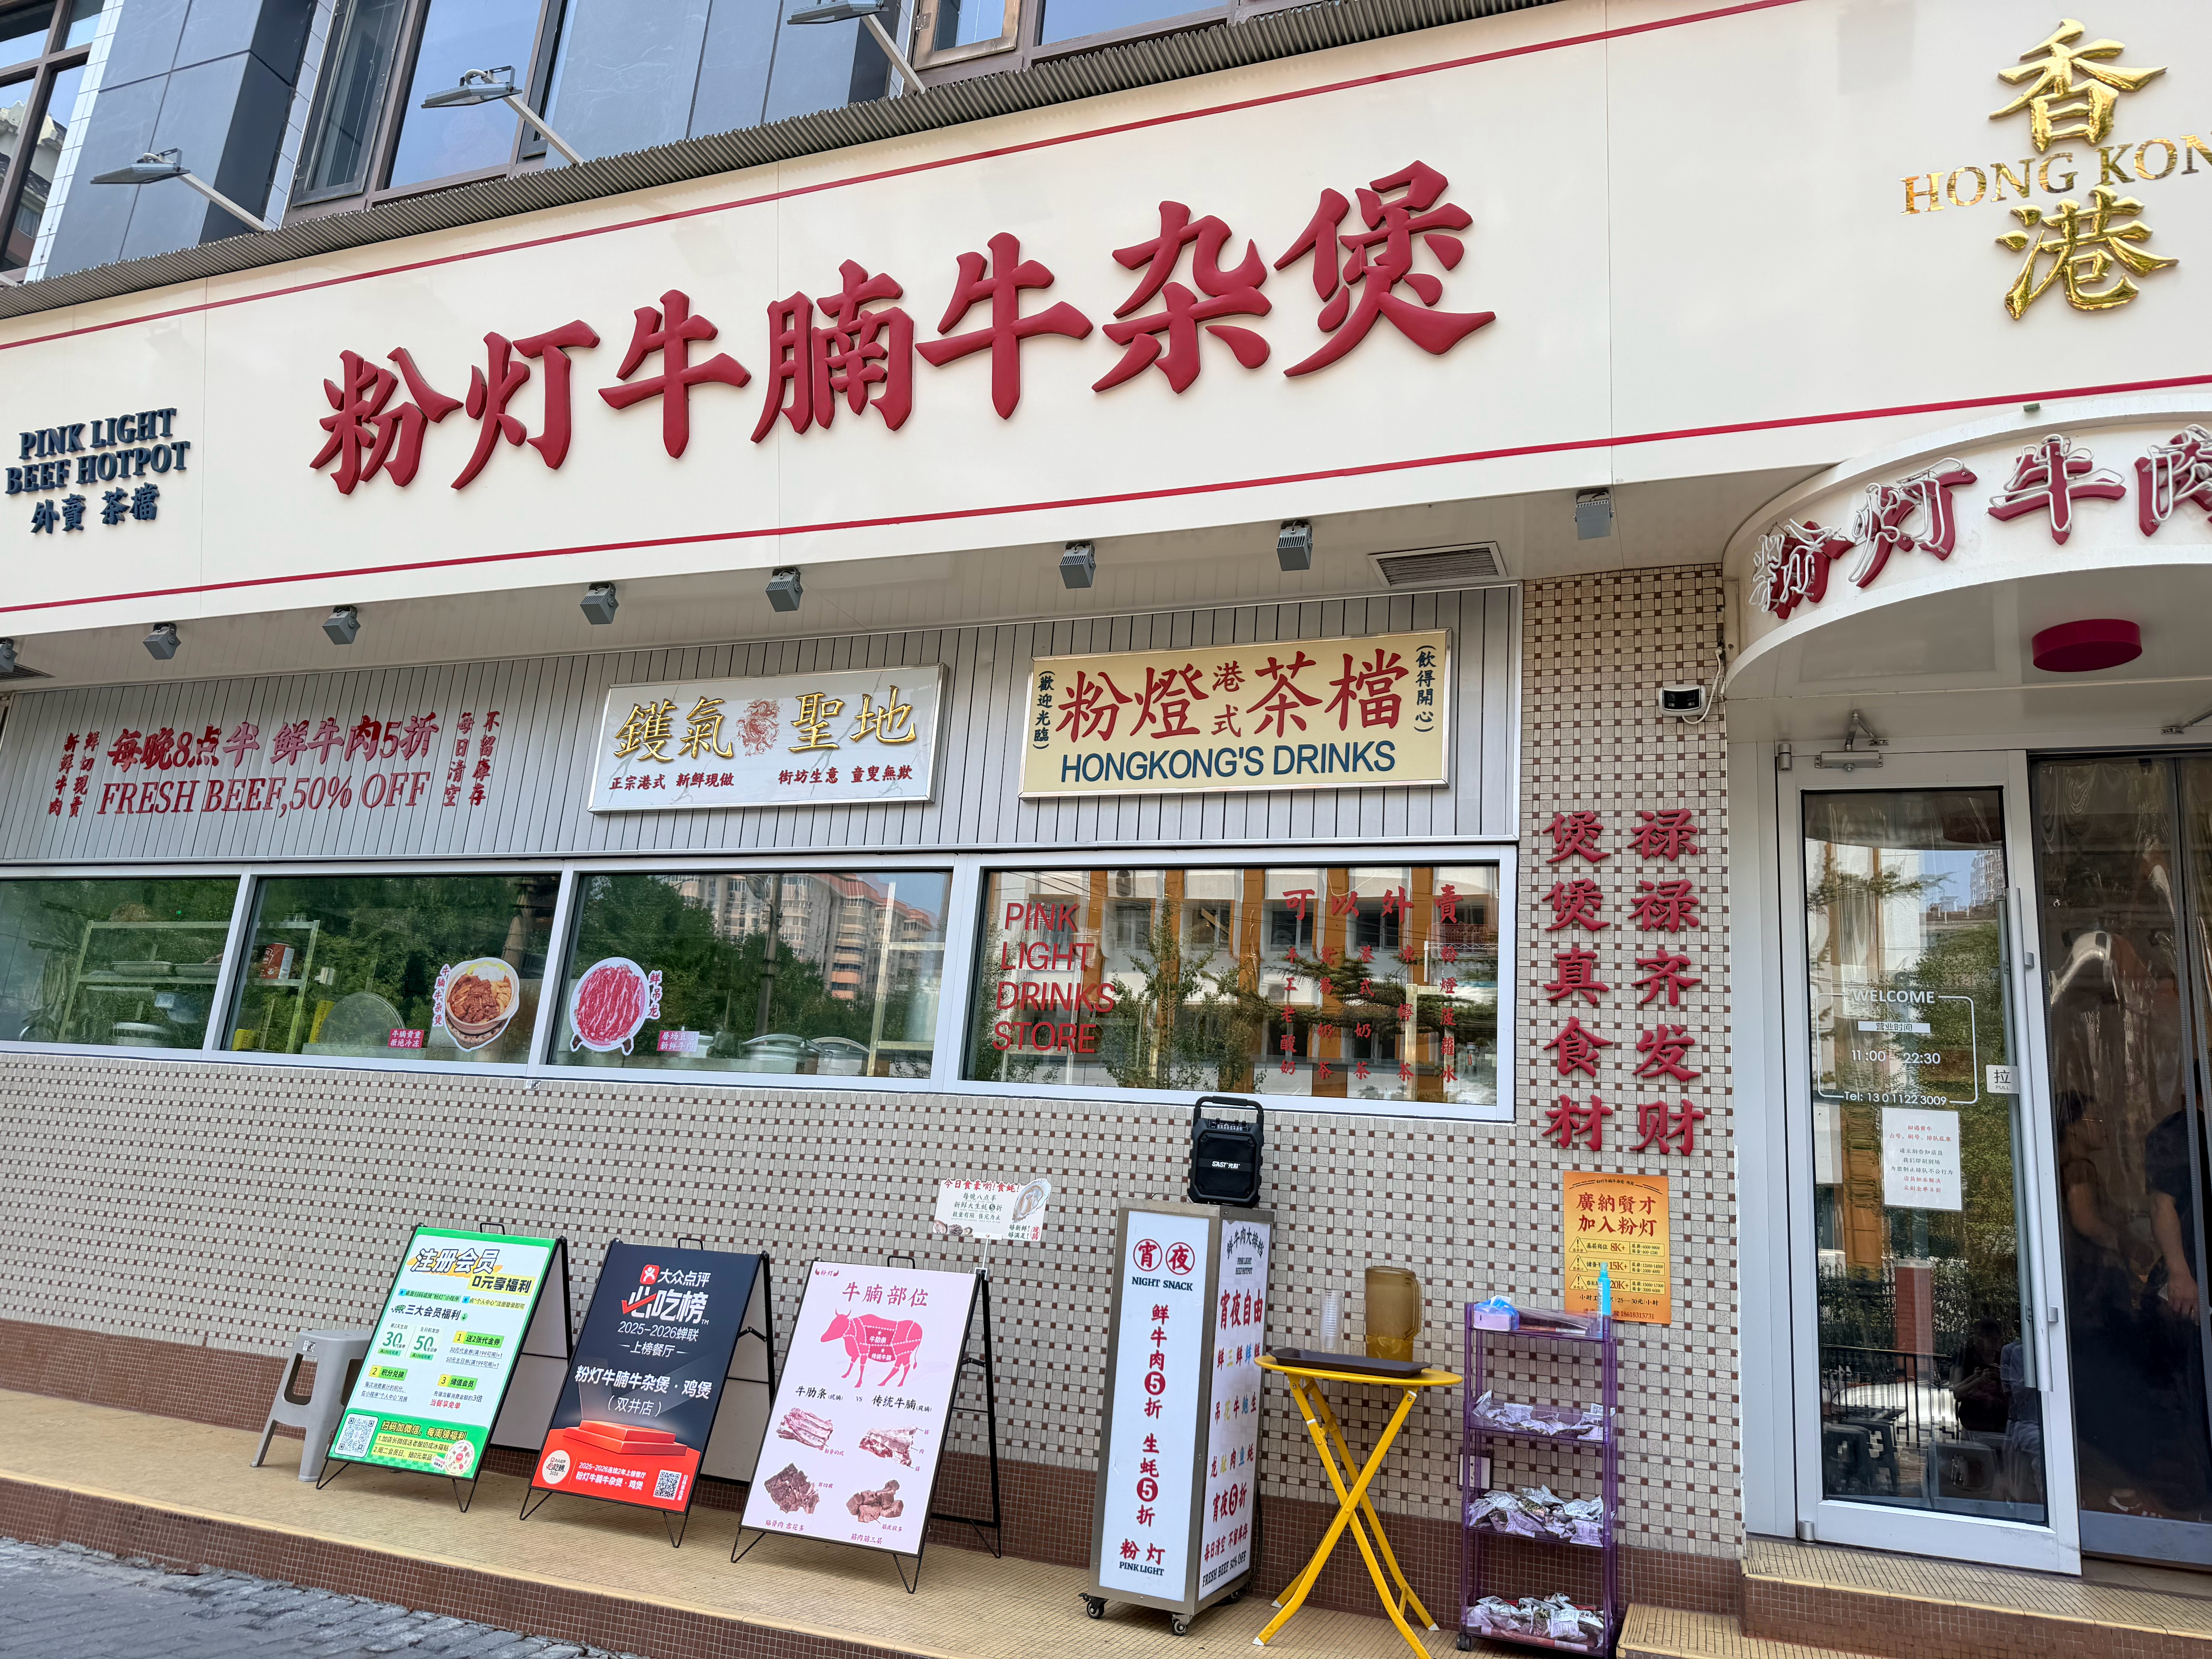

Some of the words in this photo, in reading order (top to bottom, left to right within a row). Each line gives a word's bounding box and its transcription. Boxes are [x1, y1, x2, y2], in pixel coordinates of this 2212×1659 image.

[1899, 152, 2078, 215] HONG
[309, 159, 1497, 493] 粉灯牛腩牛杂煲
[19, 422, 86, 460] PINK
[90, 407, 177, 448] LIGHT
[5, 459, 71, 495] BEEF
[76, 441, 191, 484] HOTPOT
[30, 493, 86, 534] 外賣
[100, 482, 160, 525] 茶檔
[1055, 663, 1209, 742] 粉燈
[1247, 648, 1410, 738] 茶檔
[613, 696, 735, 763] 鑊氣
[788, 685, 916, 754] 聖地
[107, 722, 259, 772] 每晚8点半
[270, 712, 439, 765] 鲜牛肉5折
[443, 712, 475, 807] 每日清空
[469, 711, 500, 806] 不留庫存
[1061, 745, 1264, 782] HONGKONG'S
[1273, 740, 1395, 774] DRINKS
[609, 773, 666, 791] 正宗港式
[778, 766, 838, 784] 街坊生意
[851, 764, 913, 783] 童叟無欺
[97, 780, 200, 814] FRESH
[361, 772, 430, 808] OFF
[1005, 901, 1080, 931] PINK
[1283, 884, 1463, 924] 可以外賣
[1000, 940, 1094, 971] LIGHT
[647, 972, 660, 1017] 鲜吊龙
[1541, 810, 1614, 1151] 煲煲真食材
[1627, 807, 1705, 1156] 禄禄齐发财
[434, 966, 449, 1025] 牛腩牛杂煲
[996, 981, 1116, 1013] DRINKS
[1852, 990, 1935, 1004] WELCOME
[1353, 945, 1375, 1080] 港式奶茶
[1875, 1022, 1913, 1032] 营业时间
[992, 1020, 1097, 1053] STORE
[1903, 1053, 1941, 1065] 22:30
[1994, 1070, 2011, 1084] 拉
[1844, 1091, 1863, 1102] Tel:
[963, 1192, 996, 1201] 每晚八点半
[1576, 1192, 1656, 1215] 廣納賢才
[1578, 1214, 1657, 1237] 加入粉灯
[410, 1248, 500, 1274] 注册会员
[1139, 1242, 1192, 1271] 宵夜
[1611, 1243, 1625, 1252] 8K+
[658, 1268, 711, 1288] 大众点评
[1609, 1261, 1628, 1271] 15K+
[472, 1275, 531, 1294] 0元享福利
[842, 1282, 928, 1307] 牛腩部位
[1132, 1276, 1160, 1288] NIGHT
[1163, 1279, 1193, 1291] SNACK
[1610, 1280, 1629, 1290] 20K+
[405, 1305, 461, 1321] 三大会员福利
[622, 1285, 709, 1323] 必吃榜
[1221, 1288, 1263, 1331] 宵夜自由
[382, 1331, 402, 1347] 30
[414, 1335, 434, 1351] 50
[465, 1334, 500, 1345] 送2张代金券
[618, 1321, 699, 1342] 2025-2026蝉联
[630, 1342, 675, 1357] 上榜餐厅
[1144, 1304, 1170, 1419] 鲜牛肉5折
[381, 1369, 404, 1378] 积分兑换
[451, 1378, 474, 1387] 储值会员
[1137, 1432, 1159, 1527] 生蚝5折
[1213, 1482, 1247, 1523] 宵夜5折
[1120, 1538, 1165, 1565] 粉灯
[1119, 1561, 1140, 1572] PINK
[1140, 1564, 1164, 1576] LIGHT
[1202, 1568, 1218, 1587] FRESH
[1218, 1561, 1229, 1578] BEEF
[1238, 1550, 1246, 1565] OFF
